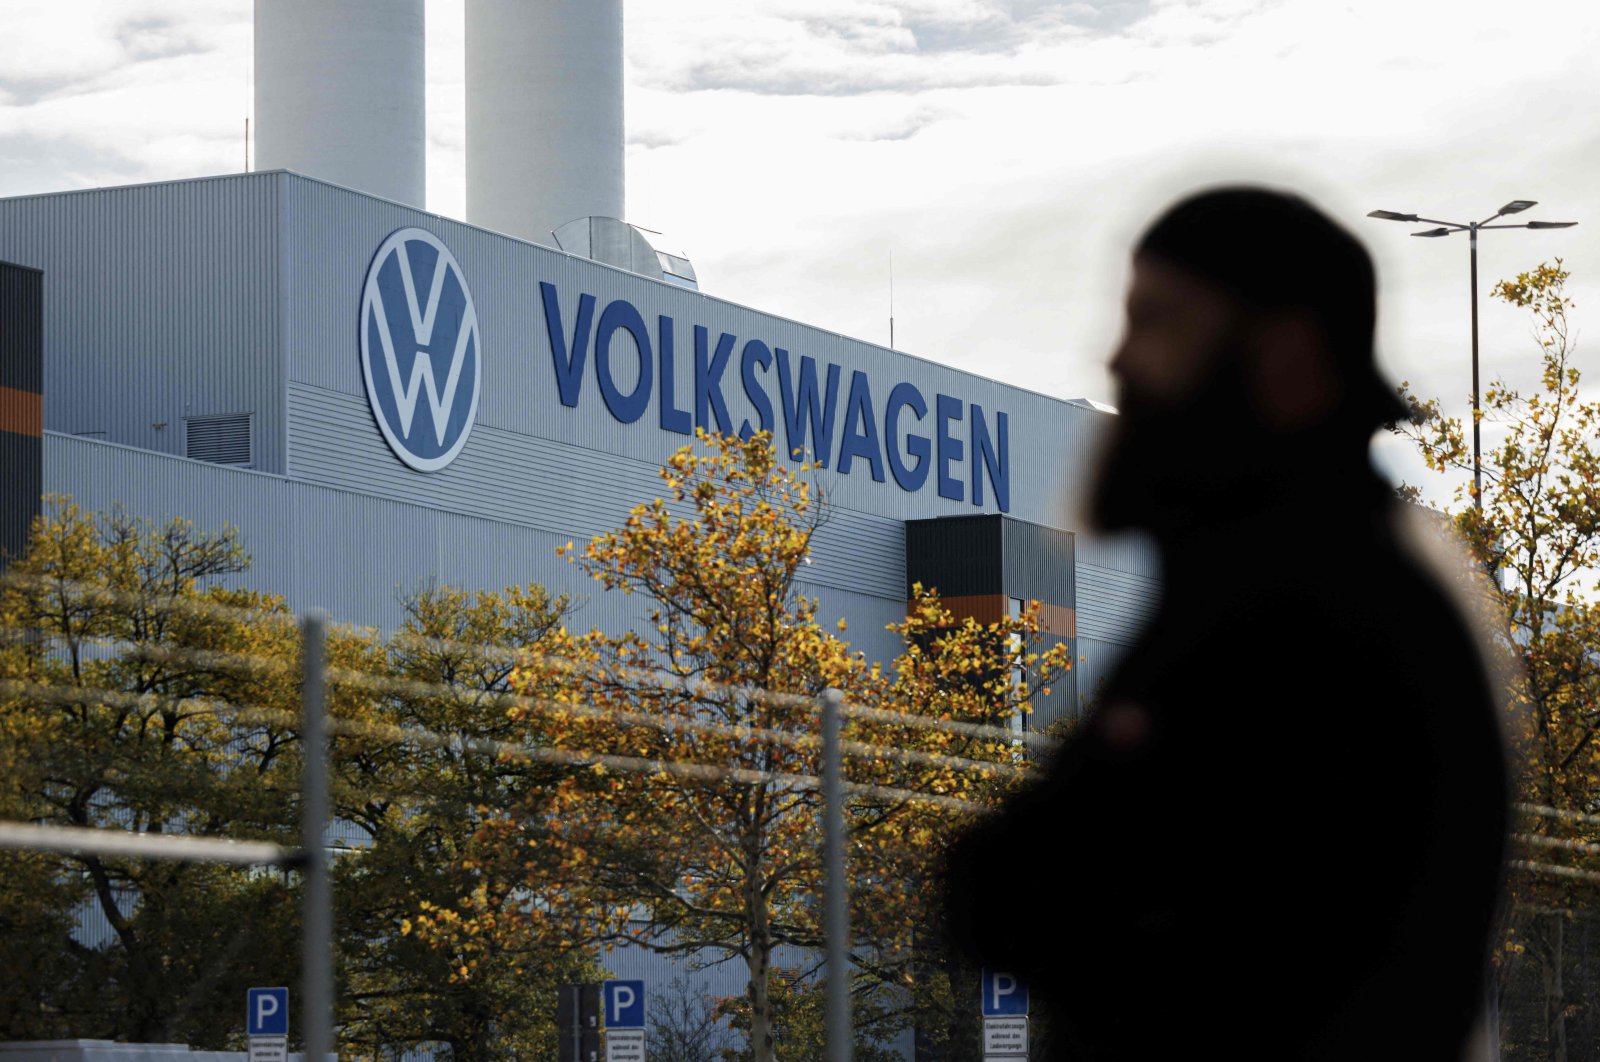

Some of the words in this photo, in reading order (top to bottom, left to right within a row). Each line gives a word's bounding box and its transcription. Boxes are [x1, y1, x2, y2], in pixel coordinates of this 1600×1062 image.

[362, 230, 479, 467] VW
[539, 281, 1010, 513] VOLKSWAGEN
[613, 985, 635, 1022] P
[993, 972, 1017, 1009] P
[257, 994, 278, 1029] P
